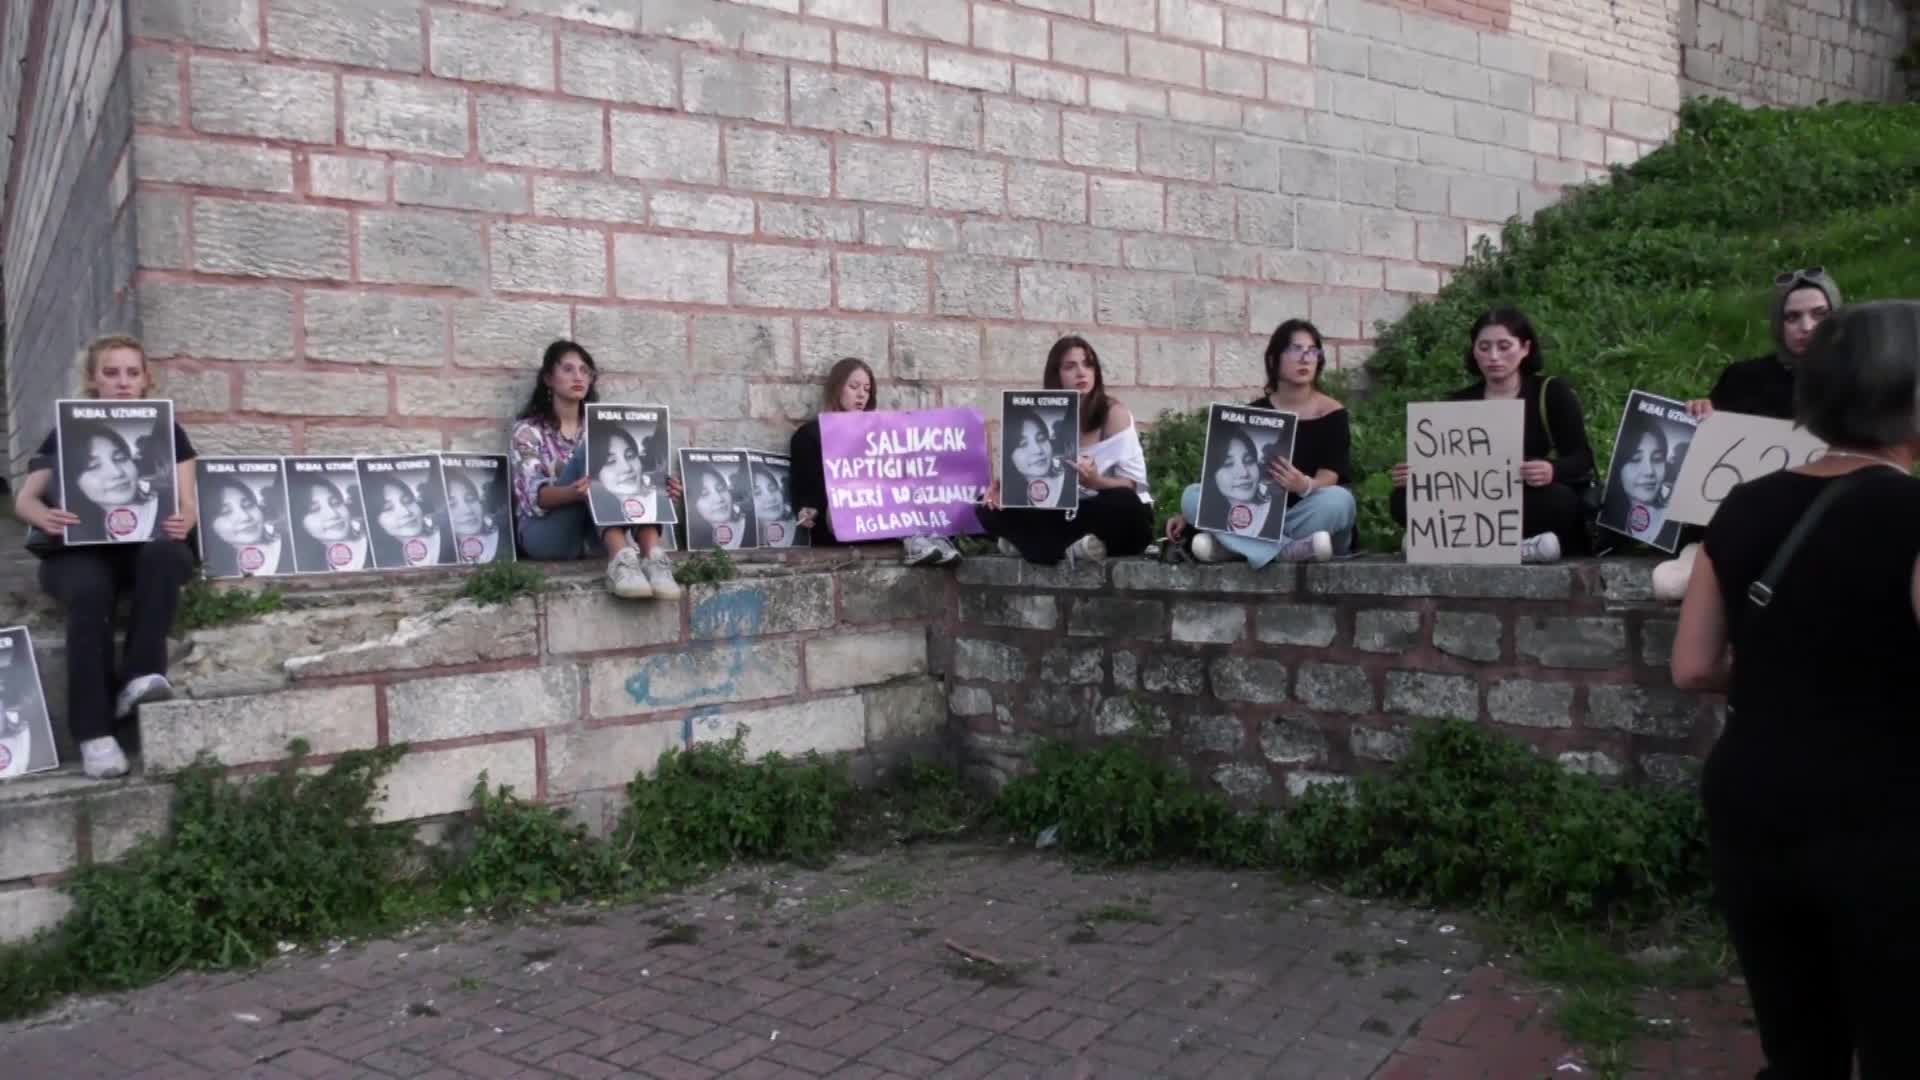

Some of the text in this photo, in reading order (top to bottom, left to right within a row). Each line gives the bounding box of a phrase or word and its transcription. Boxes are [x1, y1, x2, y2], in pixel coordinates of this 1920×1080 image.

[864, 426, 967, 456] SALINCAK
[1414, 418, 1491, 458] SIRA
[1411, 508, 1519, 549] MİZDE
